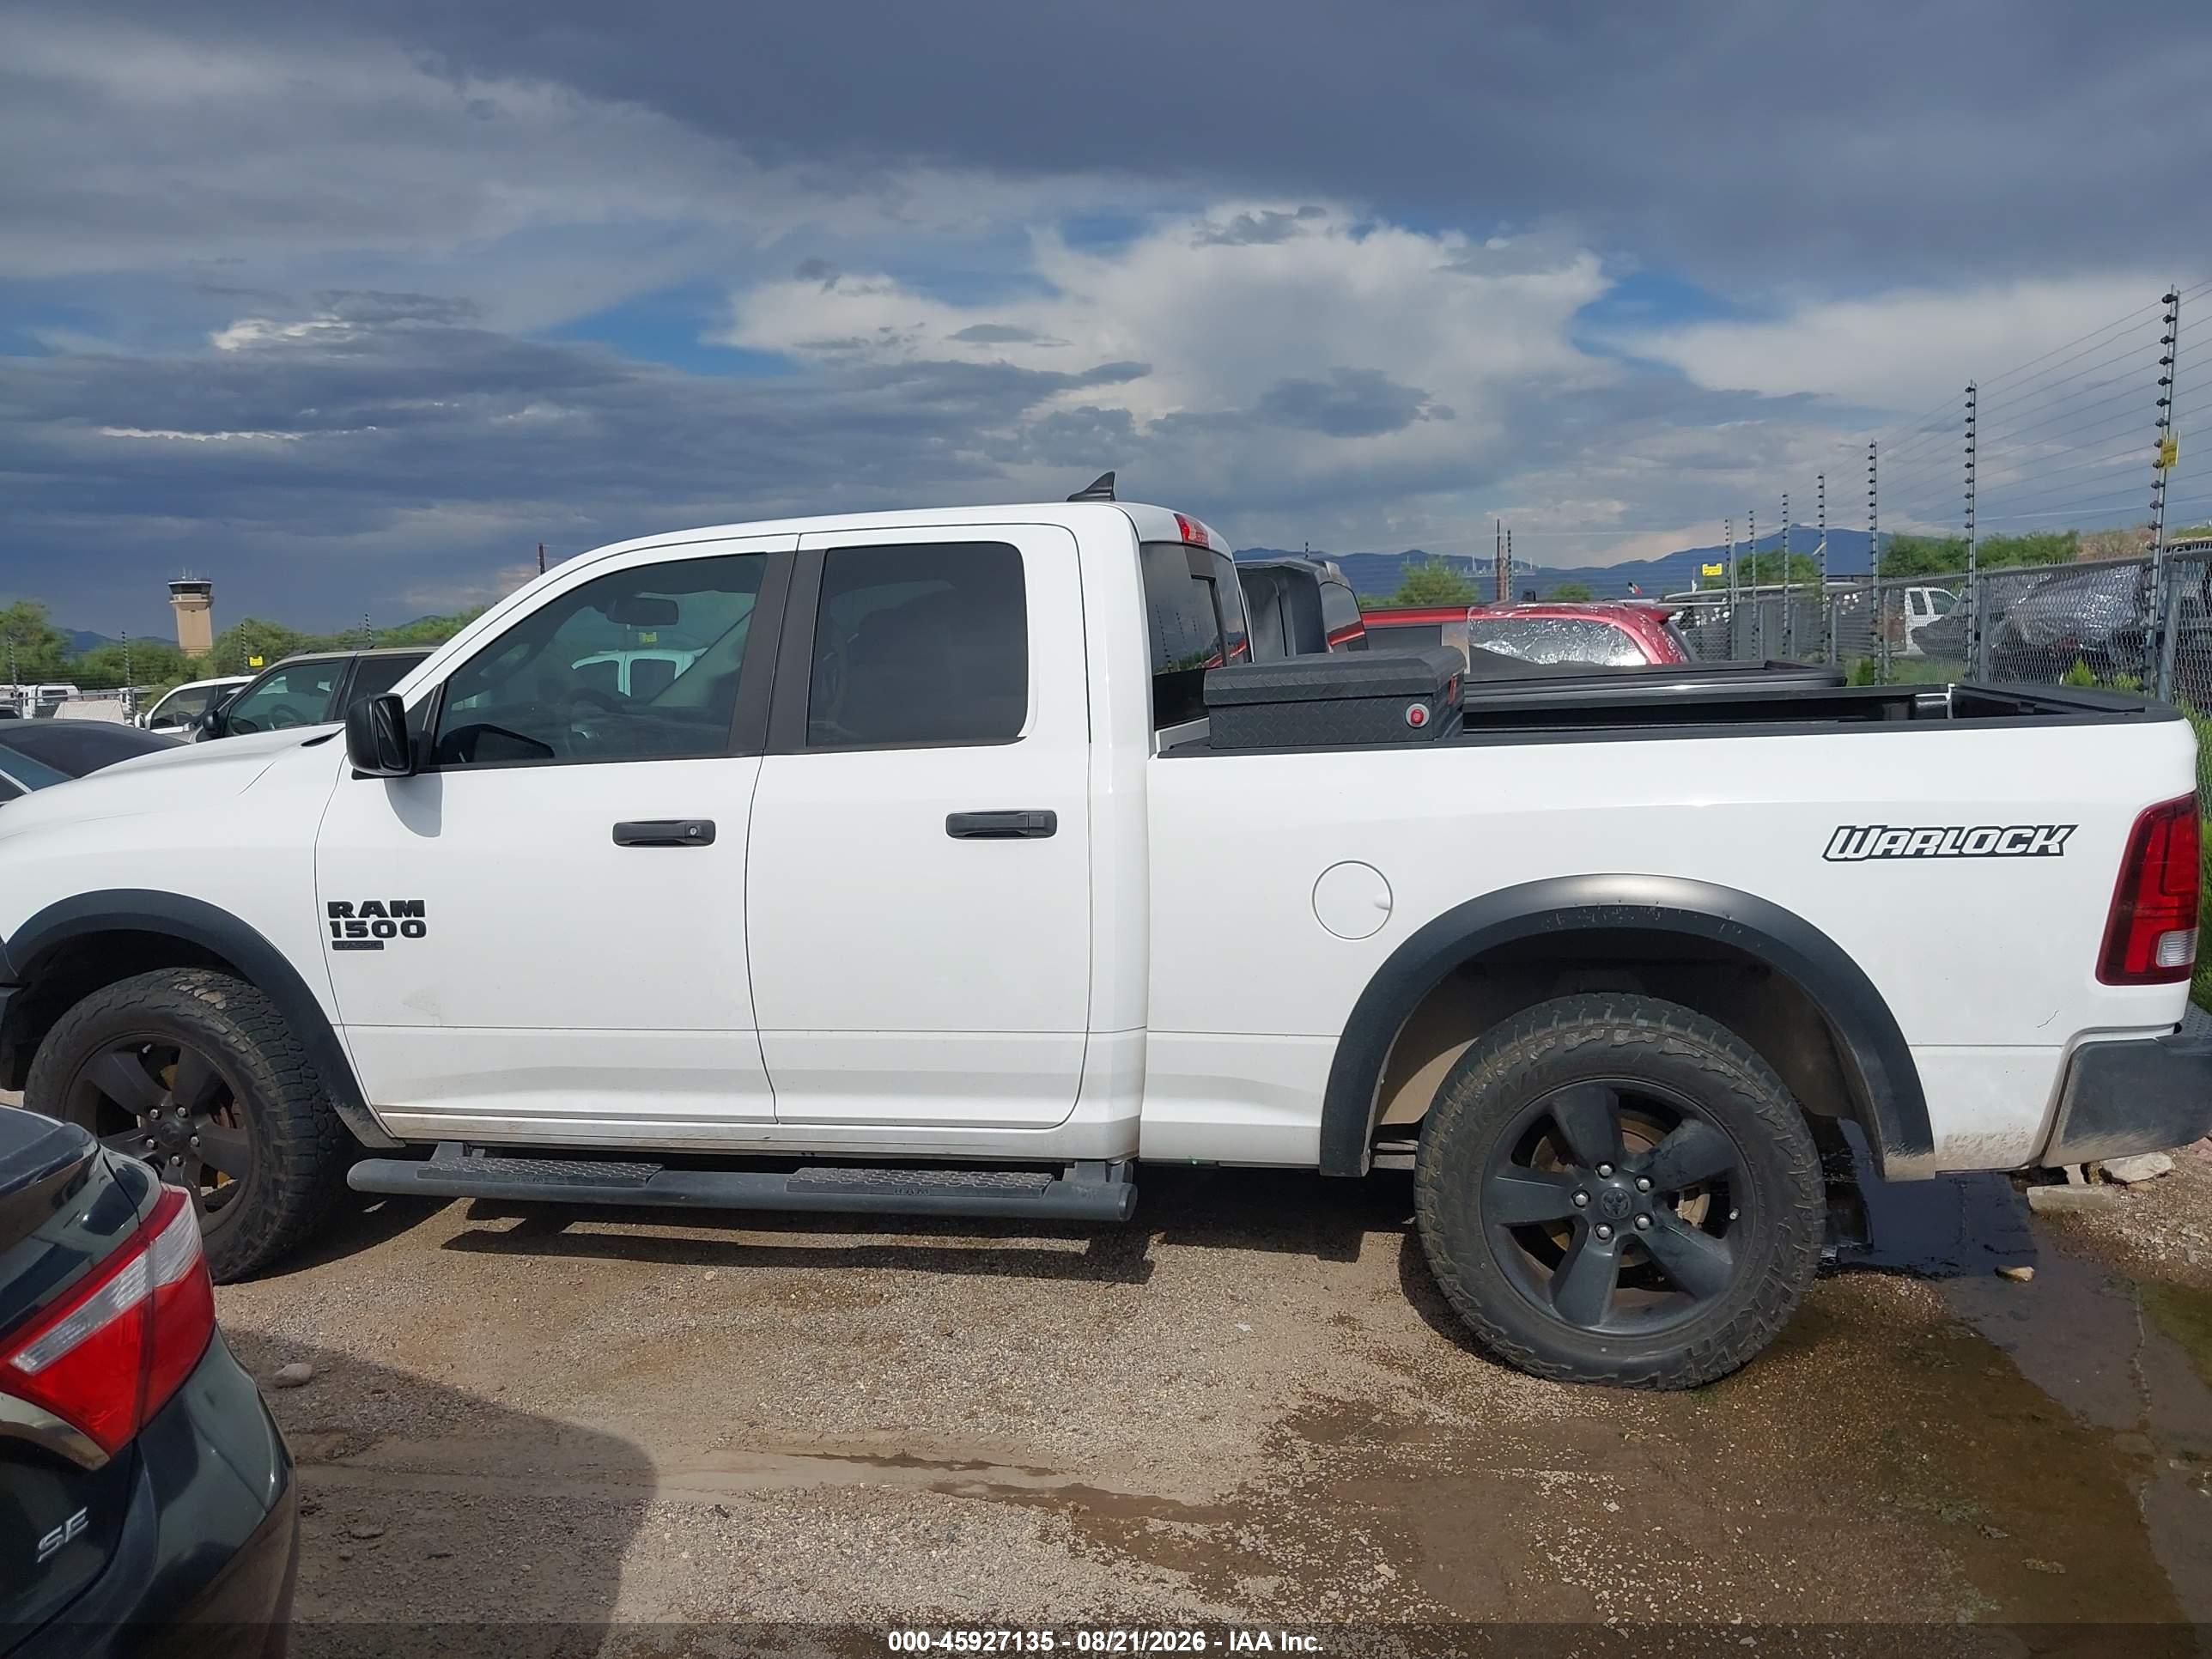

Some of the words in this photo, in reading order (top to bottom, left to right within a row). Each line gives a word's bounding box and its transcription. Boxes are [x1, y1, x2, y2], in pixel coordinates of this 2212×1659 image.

[1821, 824, 2080, 861] WARLOCK
[327, 899, 426, 919] RAM
[329, 919, 427, 939] 1500
[37, 1506, 89, 1563] SE
